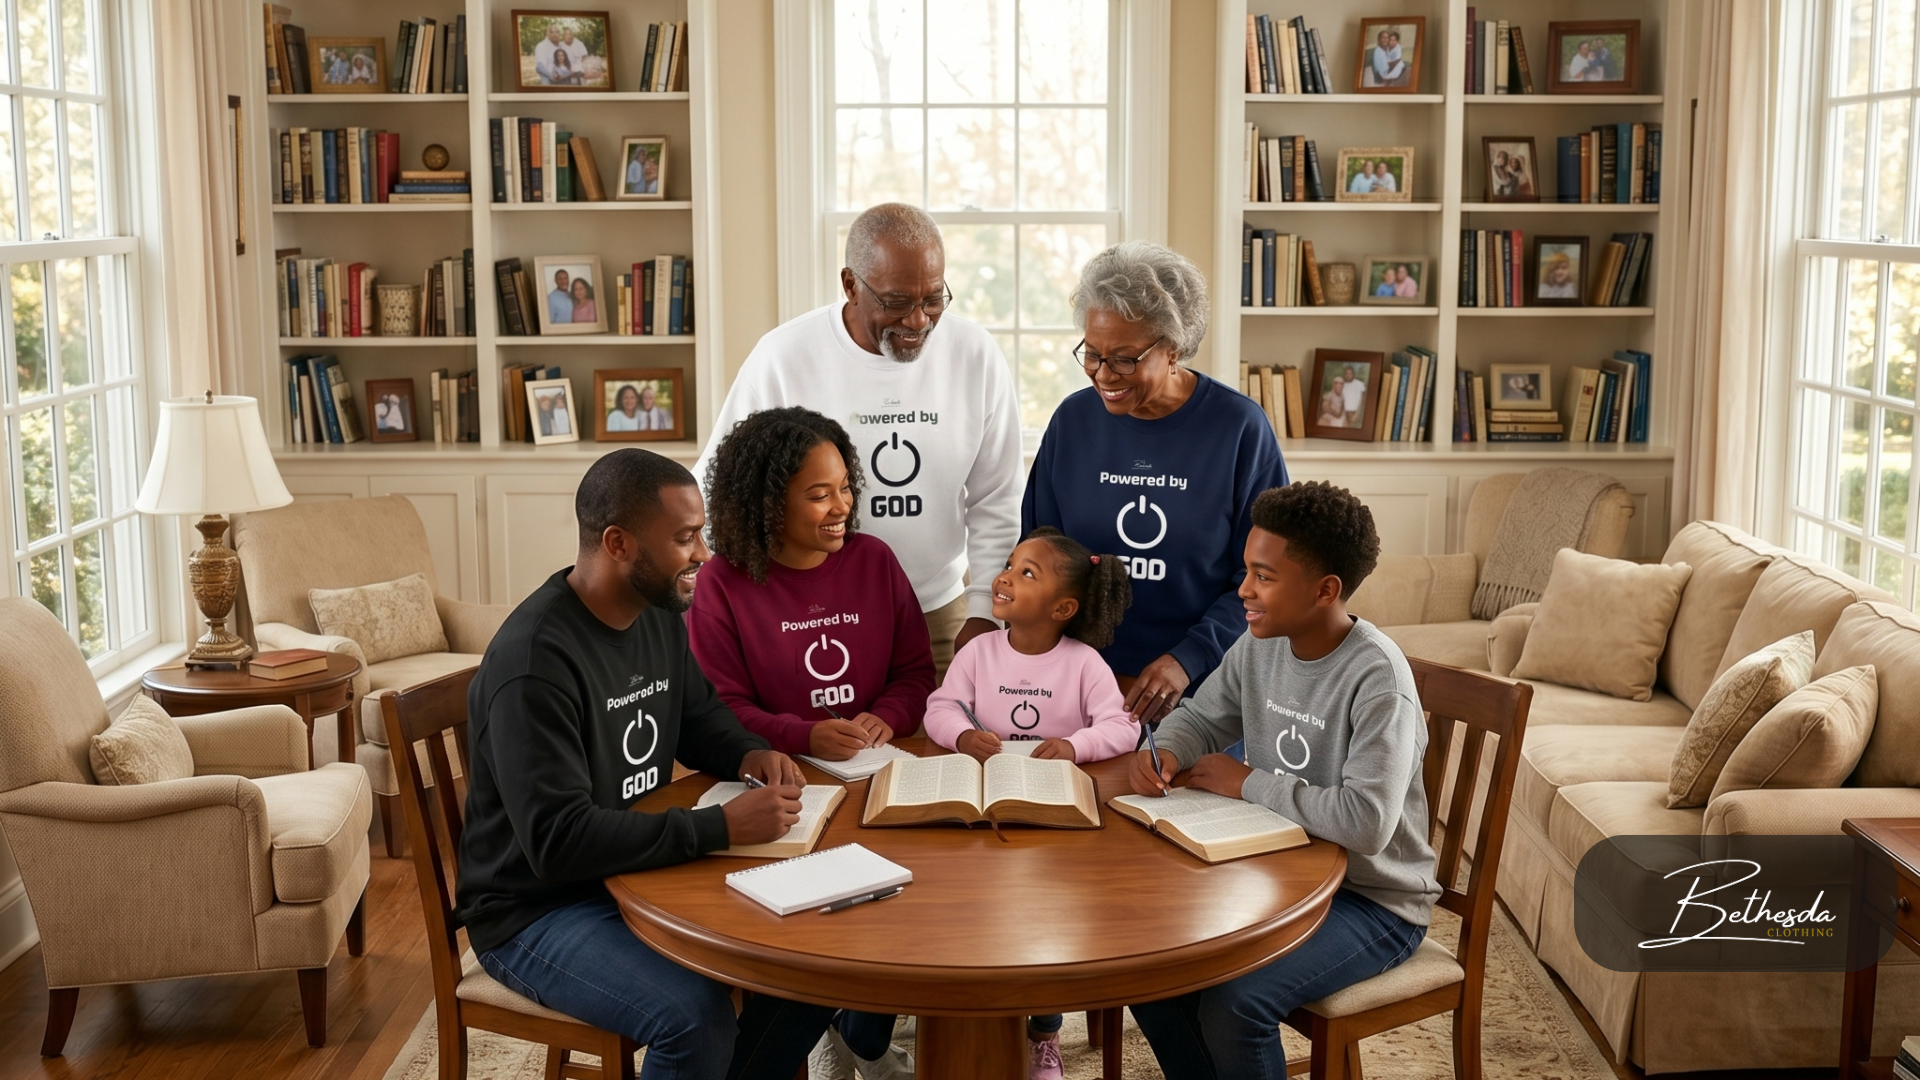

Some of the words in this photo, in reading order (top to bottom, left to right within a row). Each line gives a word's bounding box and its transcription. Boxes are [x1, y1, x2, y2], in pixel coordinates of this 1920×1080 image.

[919, 410, 939, 425] by
[1099, 471, 1166, 487] Powered
[1169, 475, 1188, 490] by
[870, 494, 923, 518] GOD
[781, 613, 840, 632] Powered
[842, 612, 860, 625] by
[607, 682, 654, 711] Powered
[656, 678, 669, 692] by
[810, 683, 855, 708] GOD
[1040, 688, 1052, 698] by
[1311, 715, 1326, 730] by
[622, 765, 659, 800] GOD
